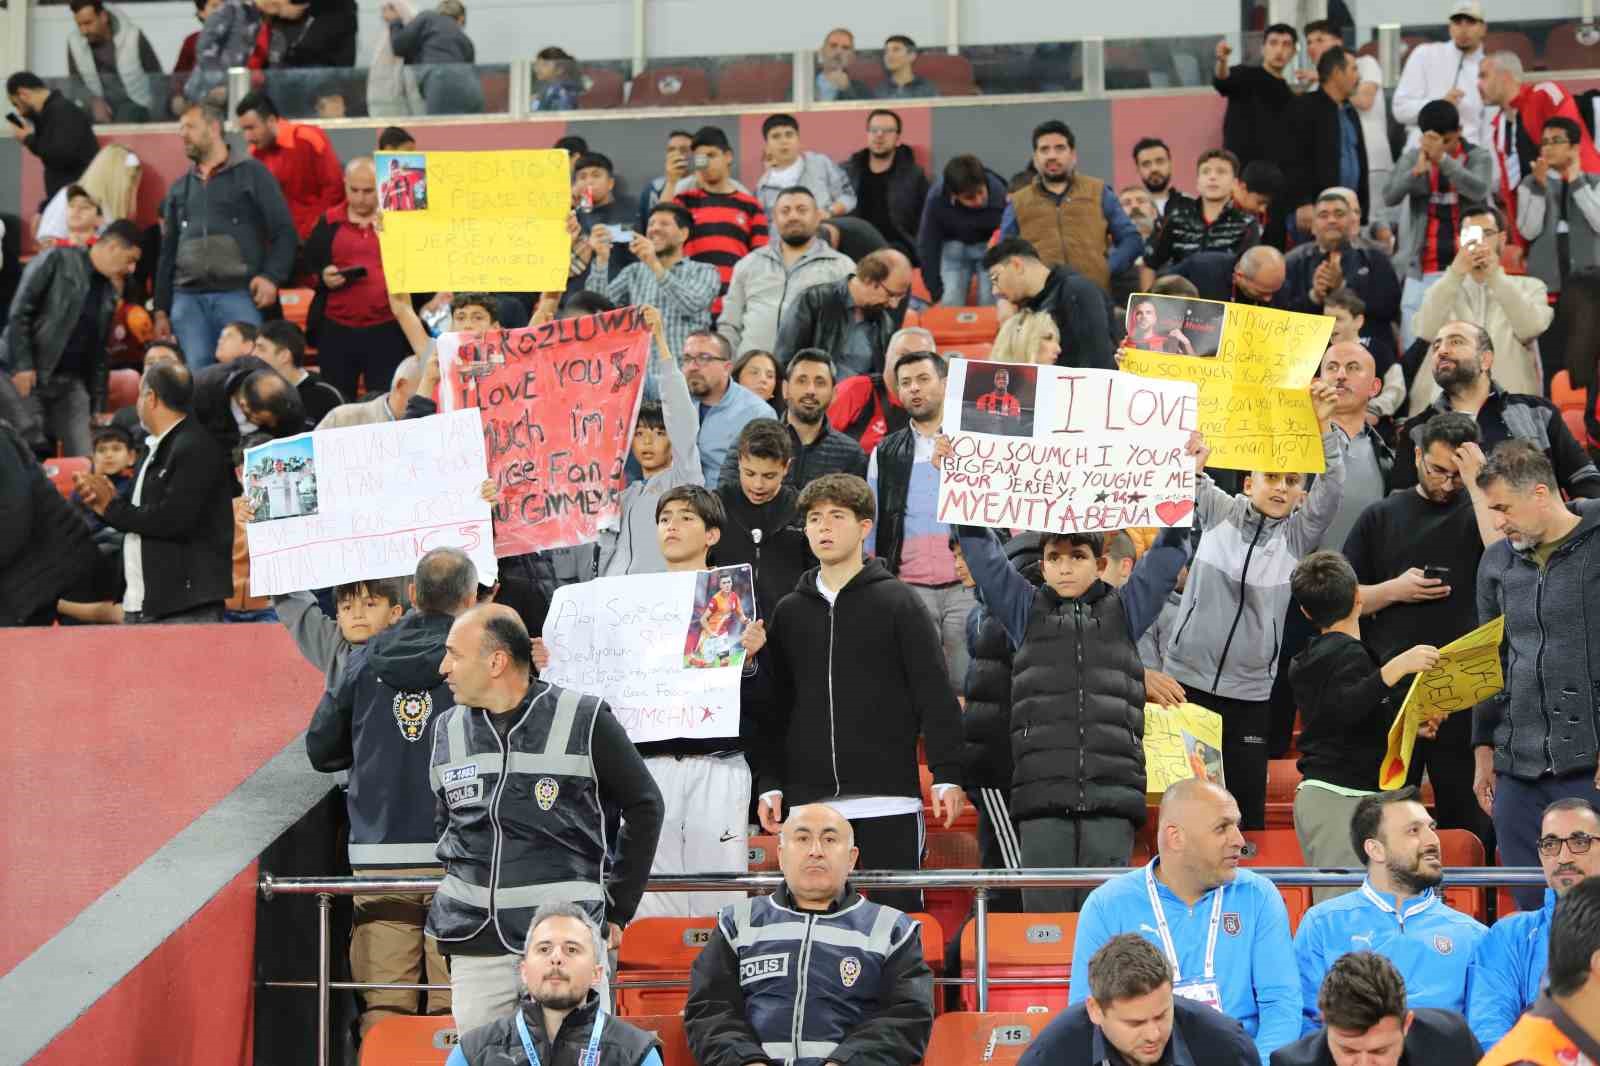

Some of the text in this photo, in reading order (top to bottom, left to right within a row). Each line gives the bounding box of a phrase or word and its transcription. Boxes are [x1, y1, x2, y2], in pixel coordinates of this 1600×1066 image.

[554, 358, 603, 387] YOU
[1052, 376, 1087, 433] I
[1105, 377, 1197, 433] LOVE
[1094, 445, 1113, 468] I
[1126, 444, 1182, 468] YOUR
[943, 471, 992, 489] YOUR
[1034, 468, 1072, 486] CAN
[1165, 470, 1194, 488] ME
[693, 932, 709, 943] 13
[1006, 1030, 1021, 1040] 15
